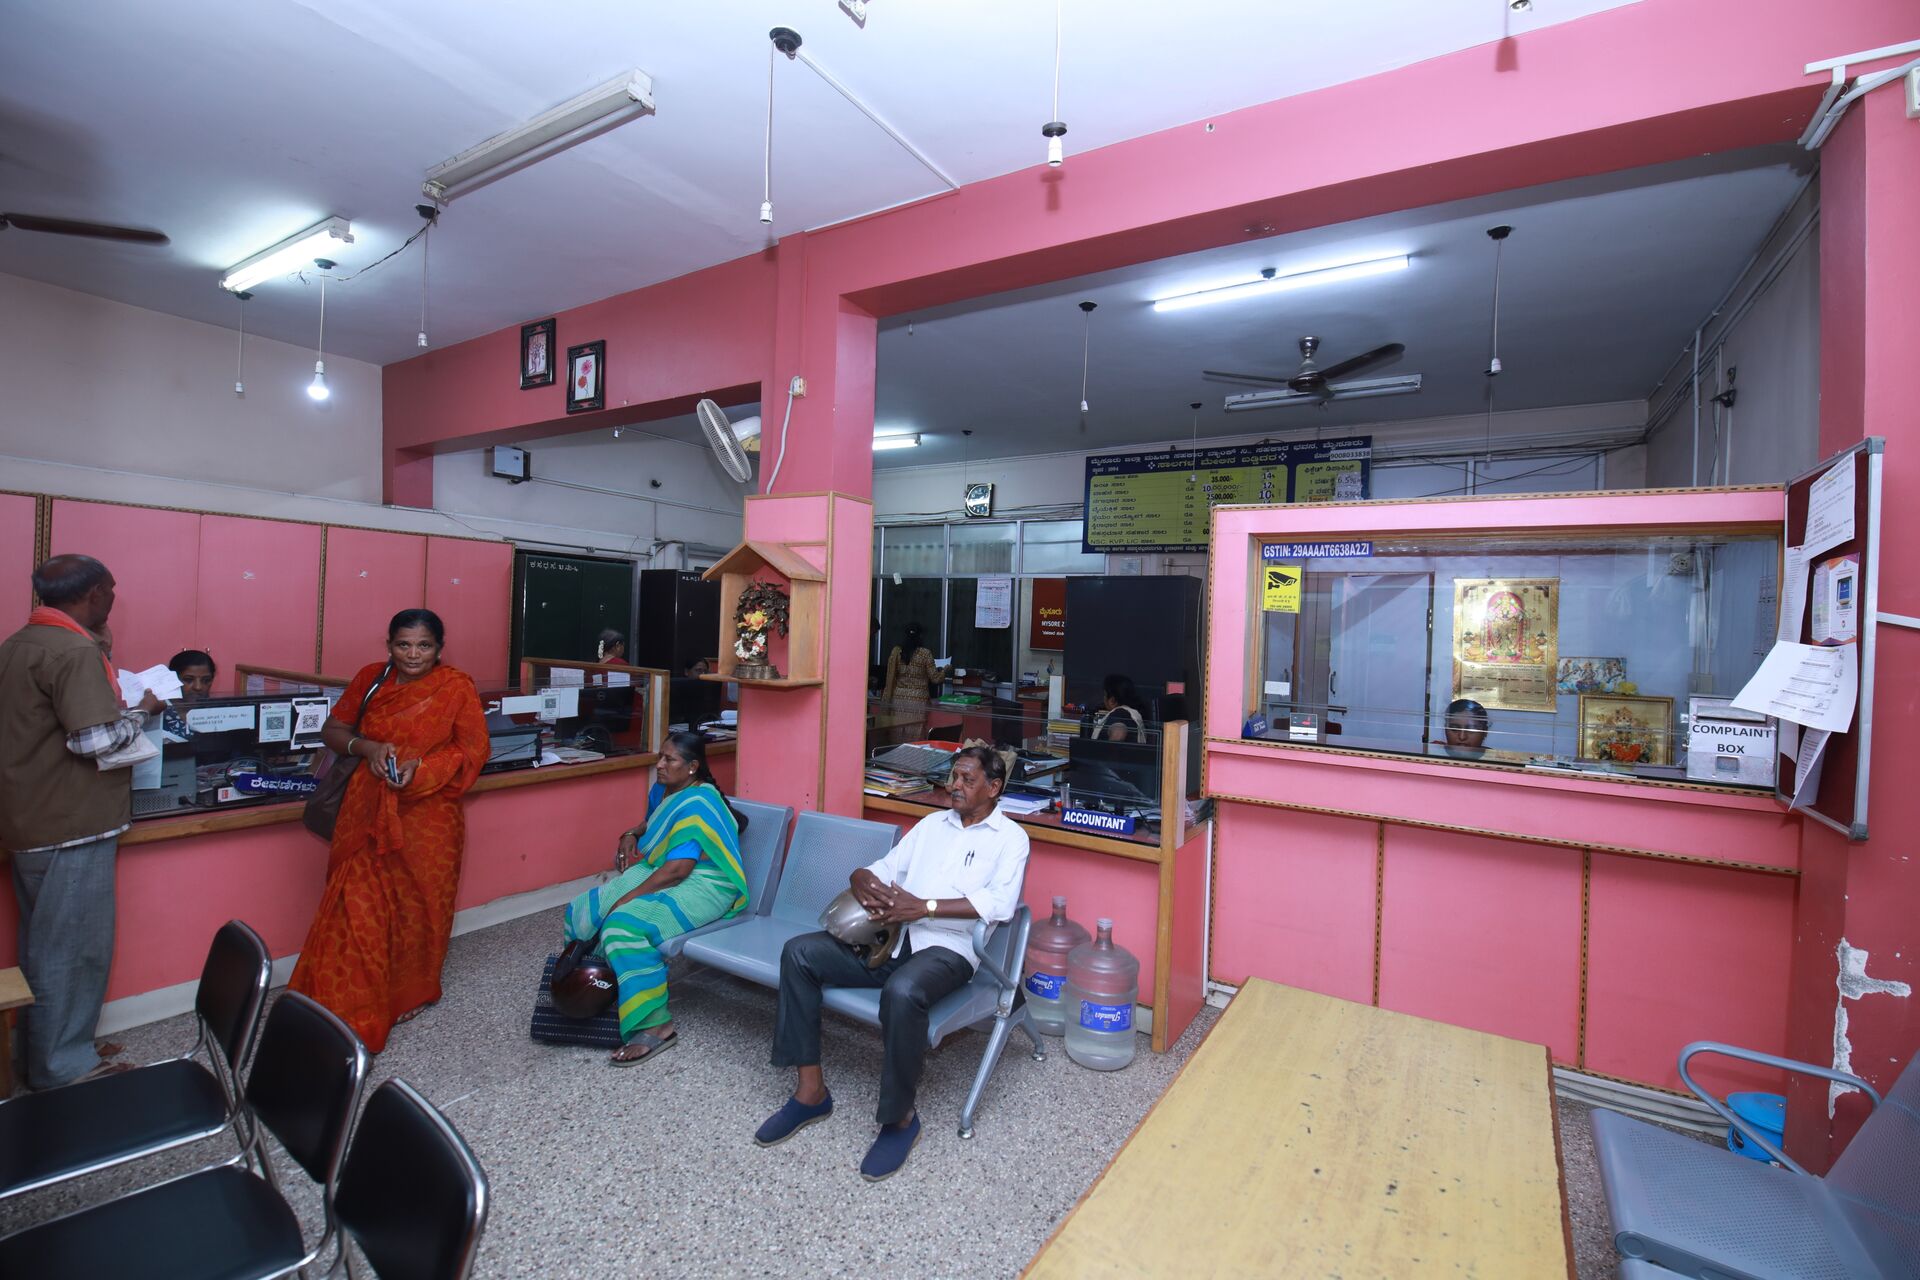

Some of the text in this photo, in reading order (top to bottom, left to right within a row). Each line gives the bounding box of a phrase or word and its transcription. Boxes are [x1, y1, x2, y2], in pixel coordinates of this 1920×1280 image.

[1263, 545, 1291, 558] GSTIN:
[1692, 724, 1772, 739] COMPLAINT
[1717, 743, 1745, 754] BOX
[1063, 811, 1126, 831] ACCOUNTANT
